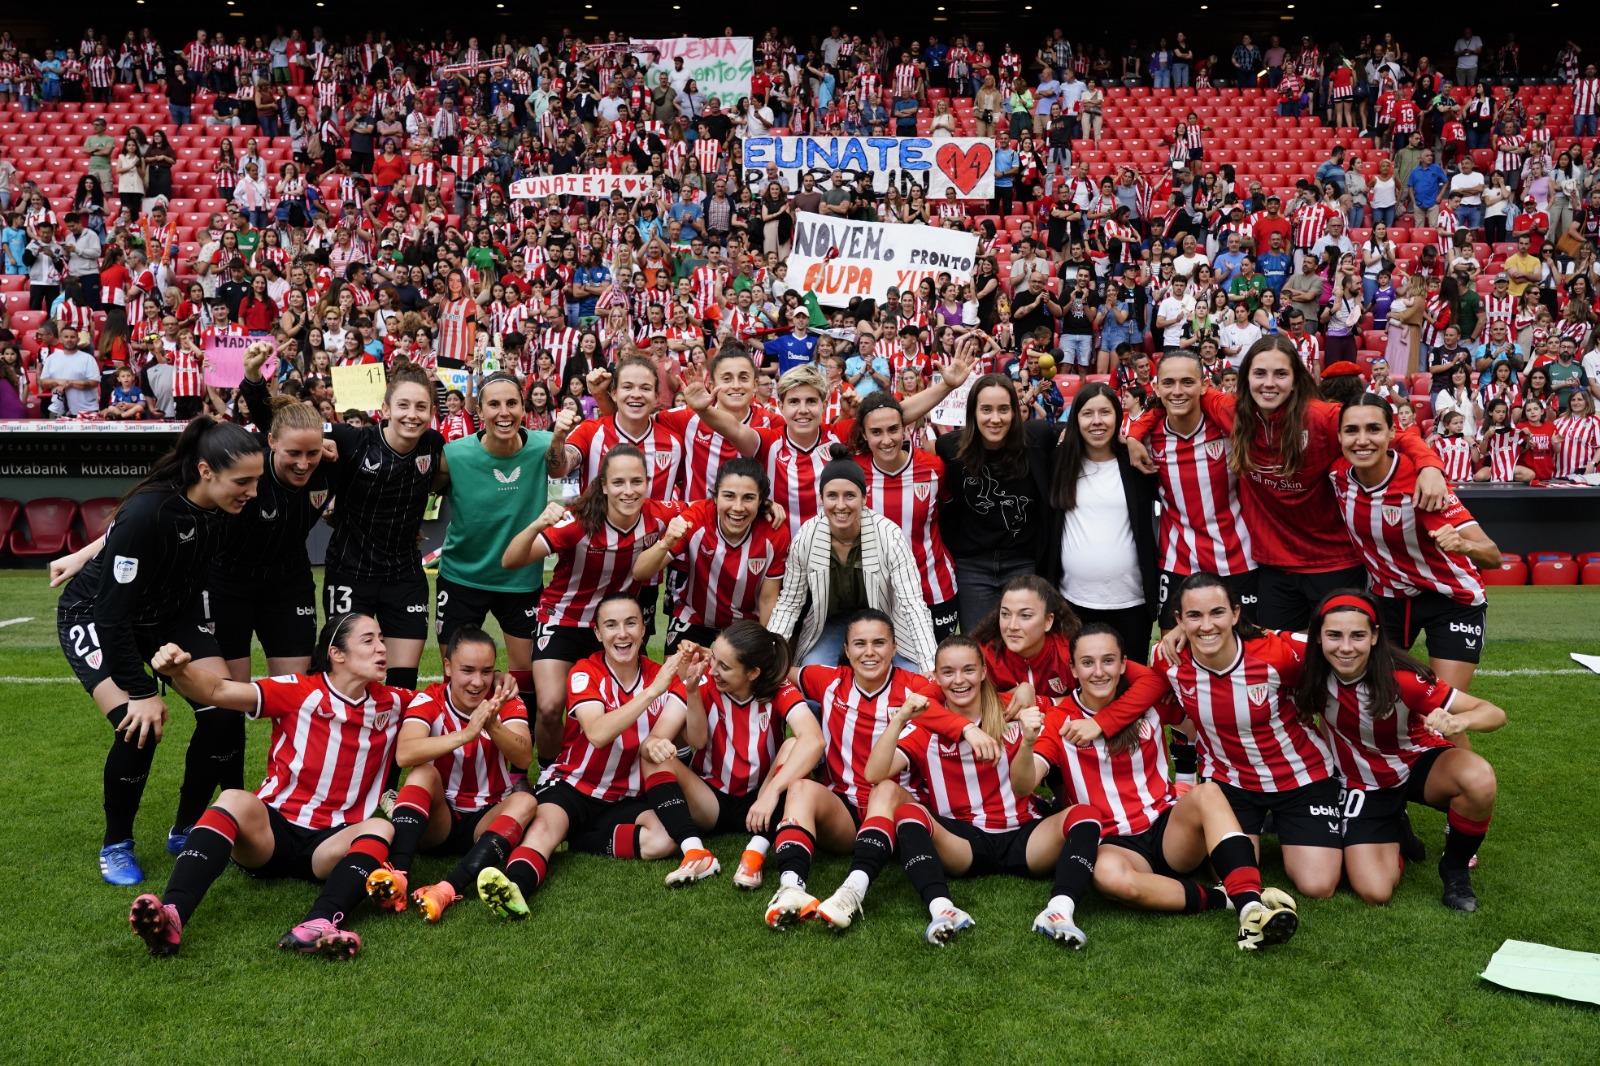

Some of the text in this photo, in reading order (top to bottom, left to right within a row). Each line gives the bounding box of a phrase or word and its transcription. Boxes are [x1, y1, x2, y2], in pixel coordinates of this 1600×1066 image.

[744, 137, 982, 181] EUNATE 14
[511, 176, 593, 195] EUNATE
[909, 248, 972, 272] PRONTO
[366, 366, 382, 384] 17
[0, 462, 68, 475] utxabank
[82, 462, 150, 475] kutxaban
[1264, 479, 1278, 489] my
[1280, 479, 1303, 489] Skin
[327, 585, 353, 615] 13
[1241, 594, 1258, 605] bb
[935, 613, 955, 627] bbk
[1449, 621, 1475, 635] bbk
[1309, 804, 1336, 817] bbk
